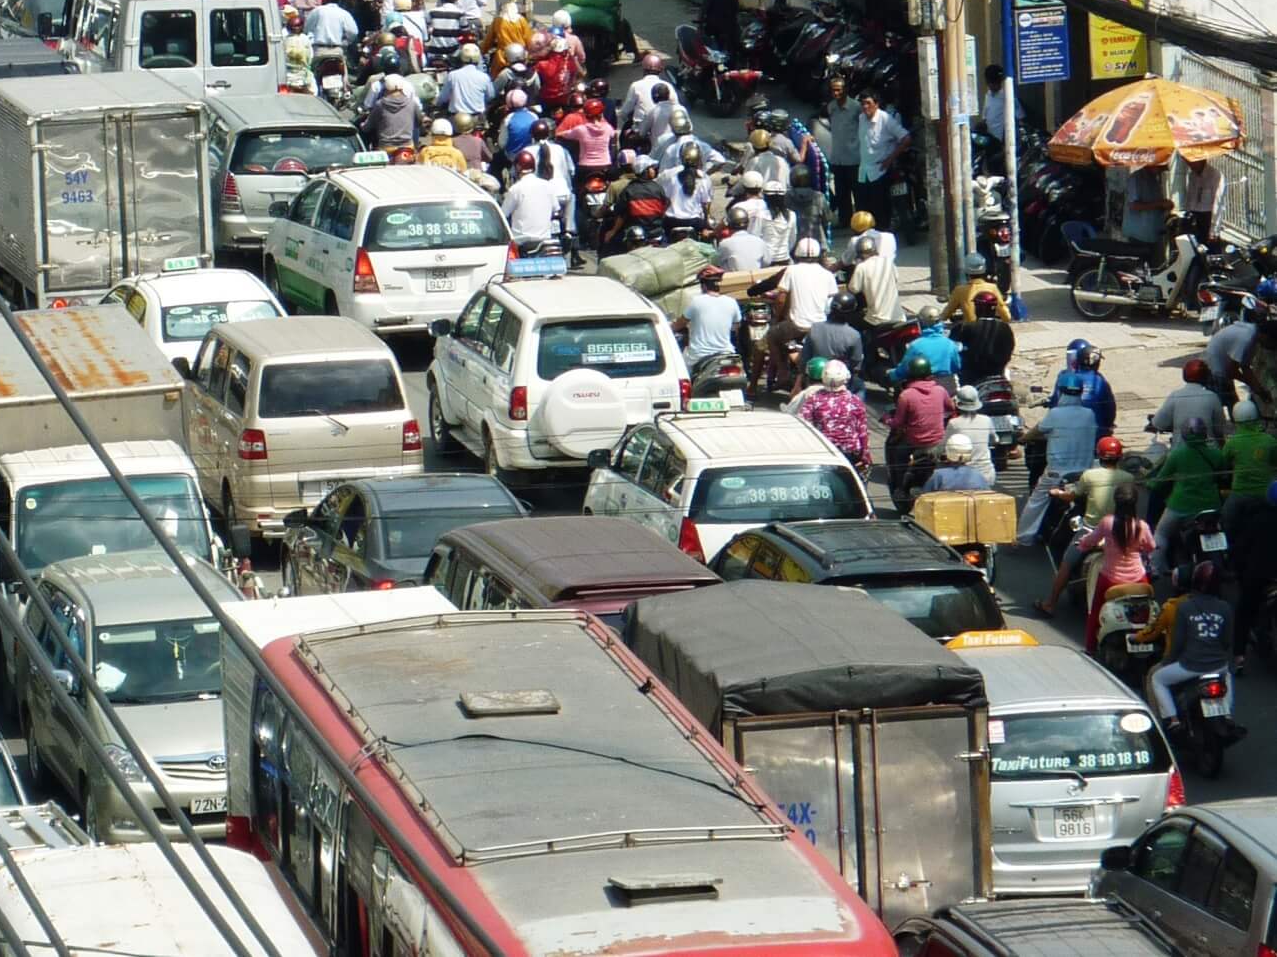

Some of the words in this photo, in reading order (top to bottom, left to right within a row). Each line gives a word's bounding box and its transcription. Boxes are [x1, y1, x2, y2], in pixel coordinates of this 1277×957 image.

[408, 223, 424, 237] 38
[426, 223, 441, 236] 38
[443, 222, 459, 235] 38
[572, 391, 601, 399] ISUZU
[750, 488, 767, 503] 38
[770, 487, 788, 501] 38
[791, 486, 809, 501] 38
[1078, 753, 1096, 769] 38
[1099, 752, 1116, 768] 18
[1117, 751, 1133, 766] 18
[1134, 750, 1151, 765] 18
[1059, 822, 1092, 837] 9816
